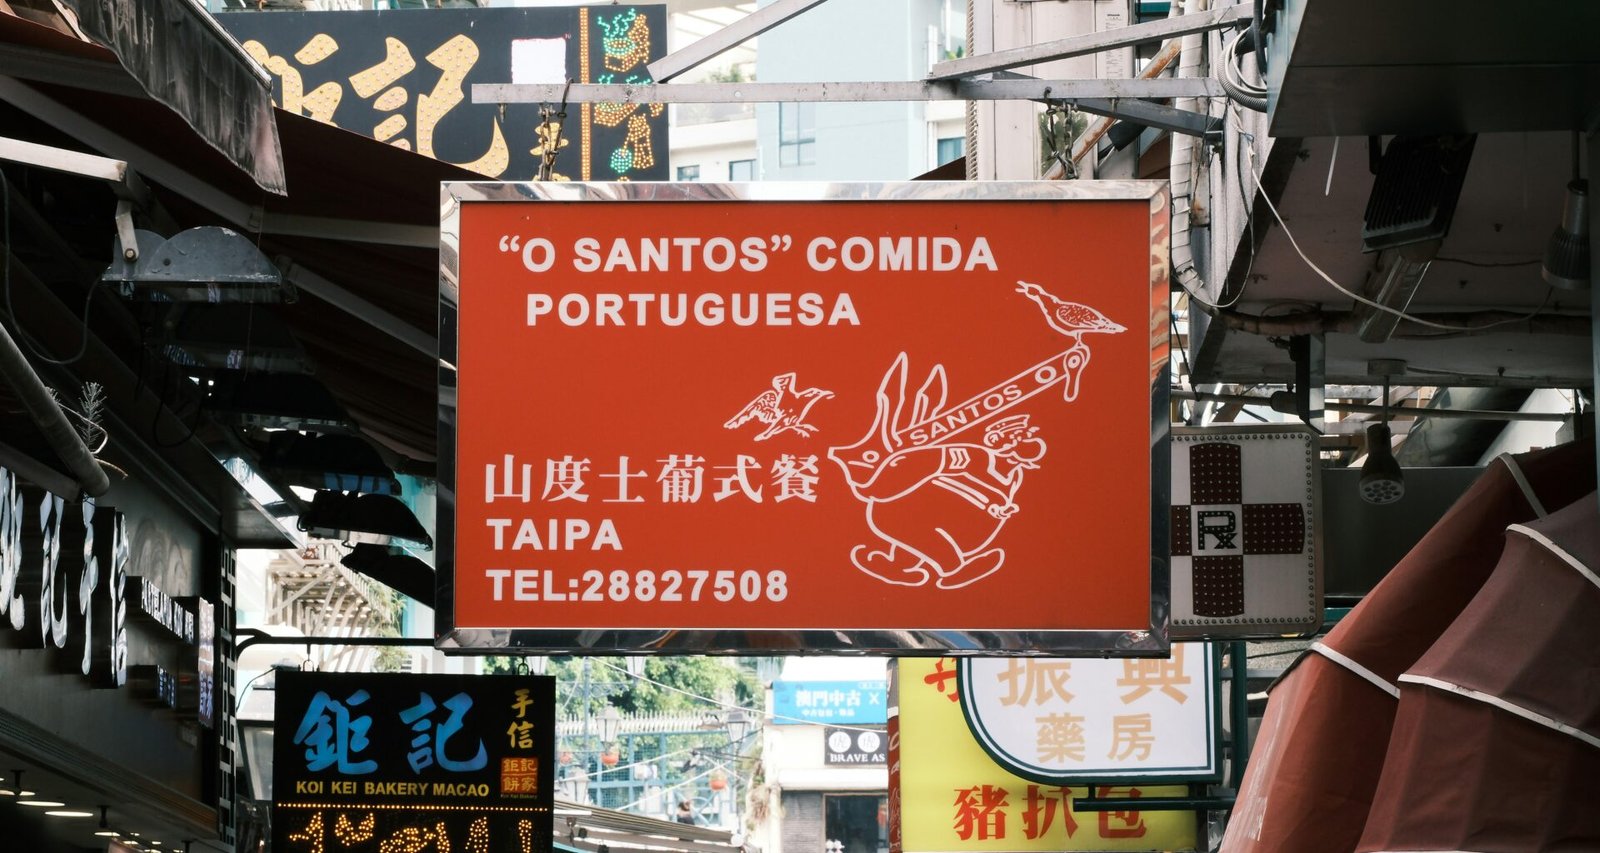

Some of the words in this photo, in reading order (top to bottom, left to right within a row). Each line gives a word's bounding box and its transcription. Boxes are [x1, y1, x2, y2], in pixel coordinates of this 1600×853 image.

[499, 235, 556, 272] “O
[573, 235, 792, 272] SANTOS”
[806, 237, 998, 271] COMIDA
[526, 293, 861, 326] PORTUGUESA
[910, 384, 1022, 446] SANTOS
[485, 454, 820, 503] 山度士葡式餐
[486, 519, 623, 550] TAIPA
[485, 570, 788, 601] TEL:28827508
[293, 688, 489, 775] 鉅記
[507, 688, 534, 749] 手信
[1035, 712, 1155, 764] 藥房
[503, 757, 538, 773] 鉅記
[830, 753, 868, 763] BRAVE
[296, 780, 323, 795] KOI
[331, 781, 357, 796] KEI
[365, 782, 428, 796] BAKERY
[433, 783, 490, 797] MACAO
